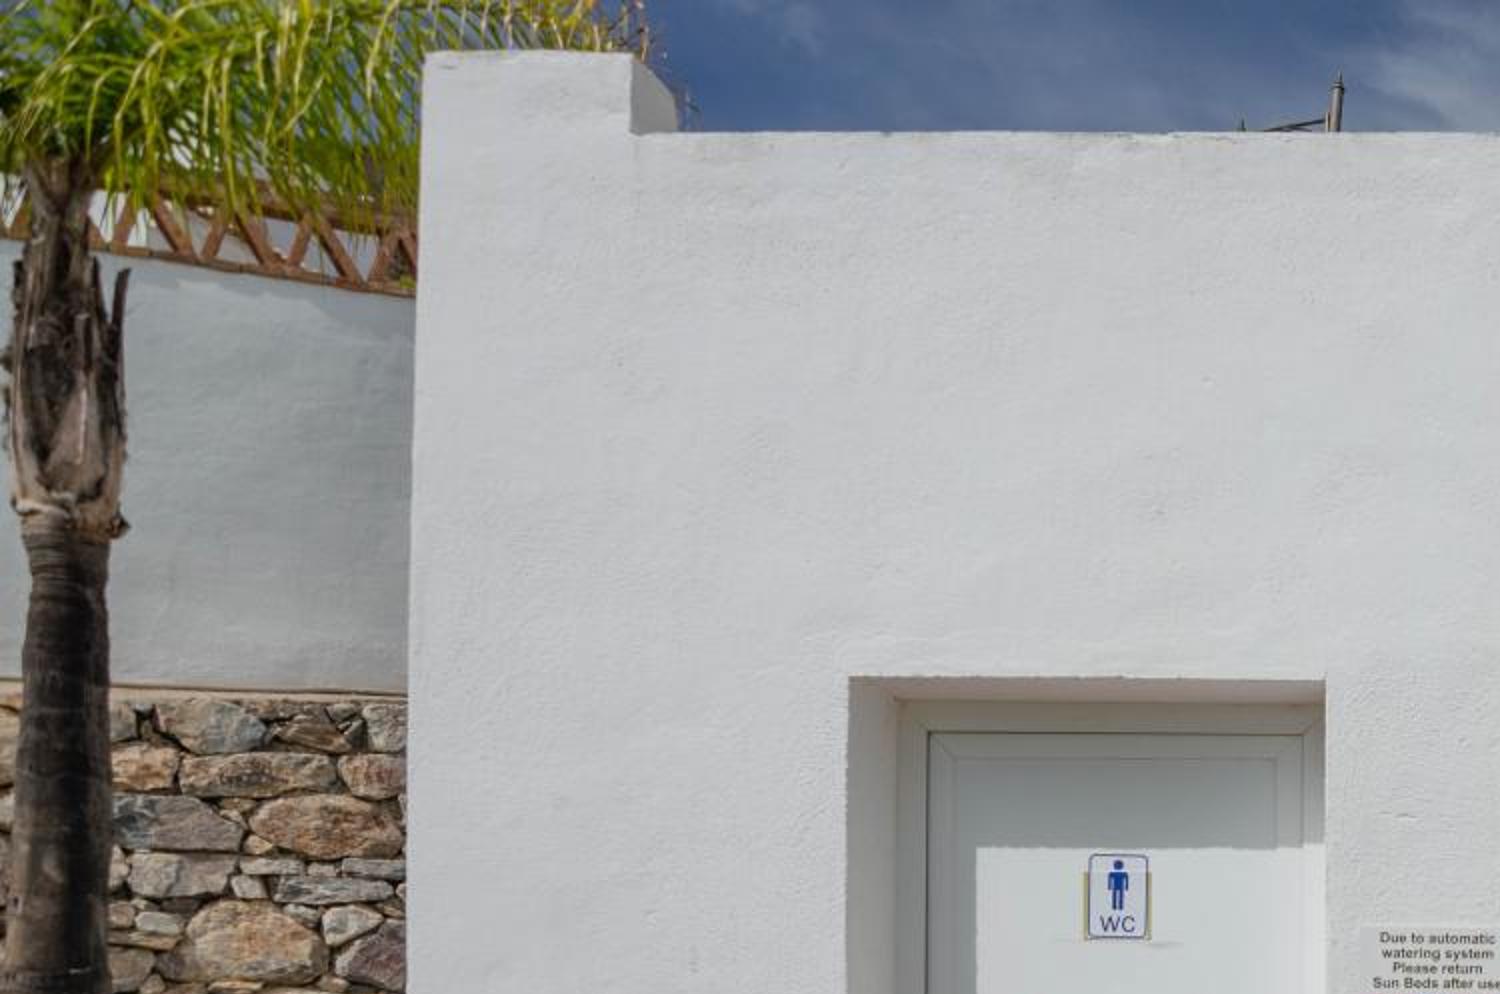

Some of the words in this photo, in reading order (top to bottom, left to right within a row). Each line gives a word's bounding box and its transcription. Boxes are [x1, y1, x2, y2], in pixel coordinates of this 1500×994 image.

[1100, 915, 1135, 933] WC
[1380, 932, 1407, 943] Due
[1411, 933, 1424, 944] to
[1429, 933, 1496, 945] automatic
[1382, 948, 1441, 961] watering
[1445, 949, 1495, 961] system
[1393, 963, 1437, 974] Please
[1441, 964, 1483, 974] return
[1373, 978, 1399, 989] Sun
[1404, 978, 1438, 989] Beds
[1443, 978, 1473, 989] after
